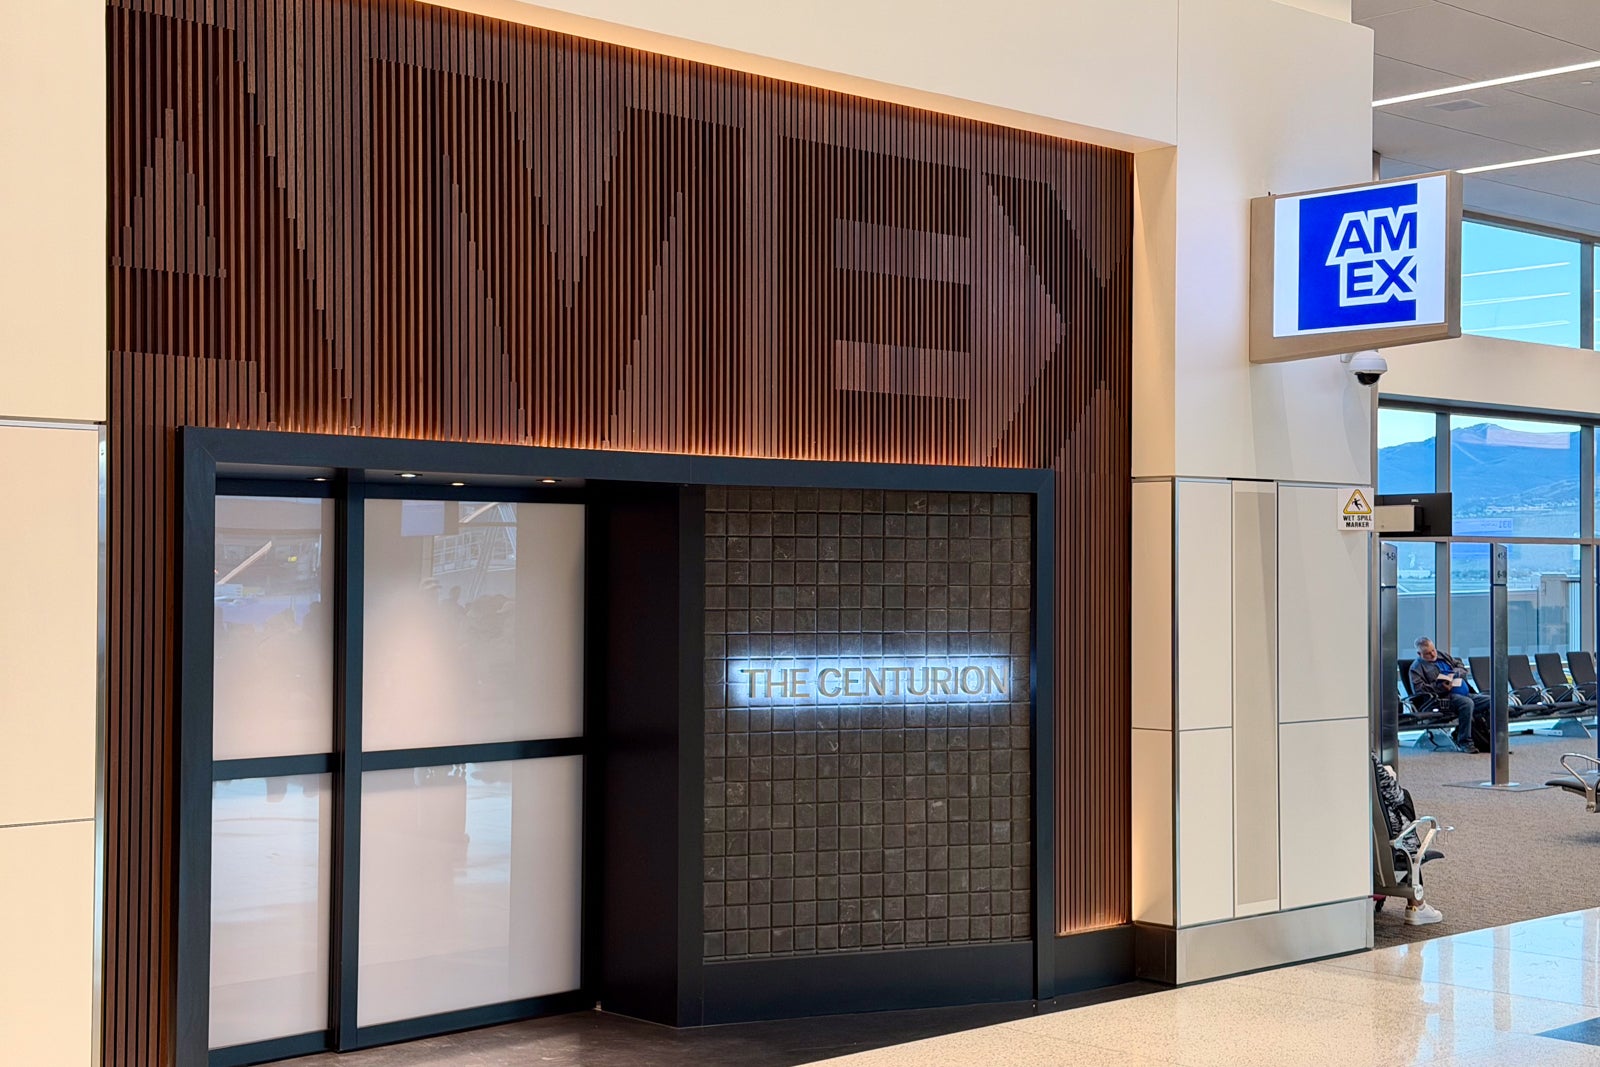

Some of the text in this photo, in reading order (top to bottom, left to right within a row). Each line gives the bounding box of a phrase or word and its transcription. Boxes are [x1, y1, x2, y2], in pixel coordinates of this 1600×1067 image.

[1335, 211, 1417, 258] AM
[1346, 255, 1416, 299] EX
[742, 665, 1009, 699] THE CENTURION
